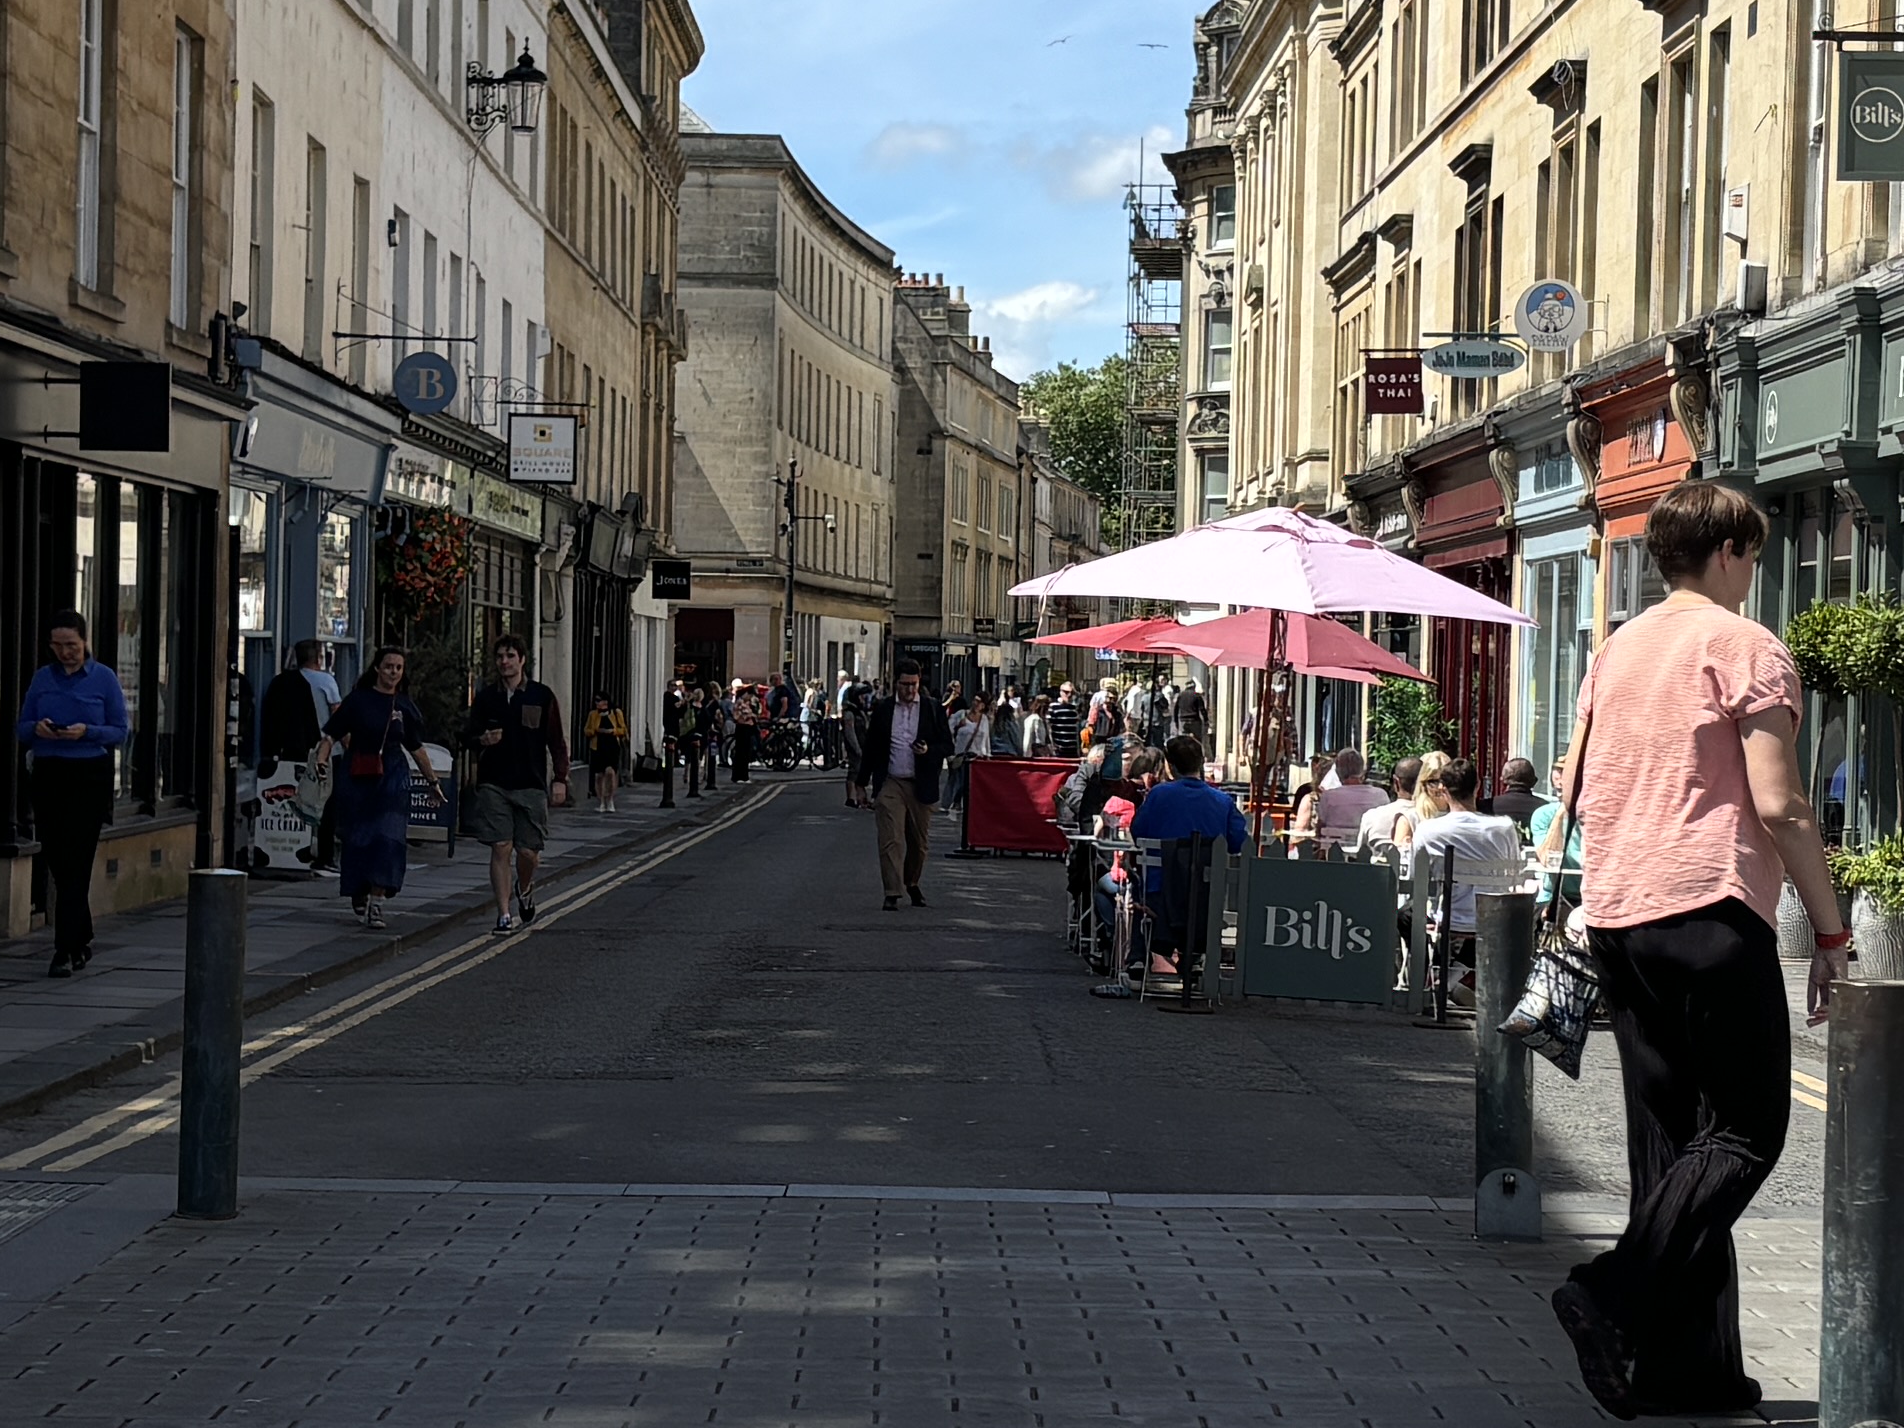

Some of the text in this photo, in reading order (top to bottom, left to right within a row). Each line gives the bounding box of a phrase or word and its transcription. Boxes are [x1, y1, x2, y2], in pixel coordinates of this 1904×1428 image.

[1856, 102, 1902, 128] Bill's
[415, 368, 444, 400] B
[1368, 373, 1420, 383] ROSA'S
[1377, 388, 1412, 398] THAI
[513, 447, 572, 459] SQUARE
[1262, 900, 1372, 960] Bill's
